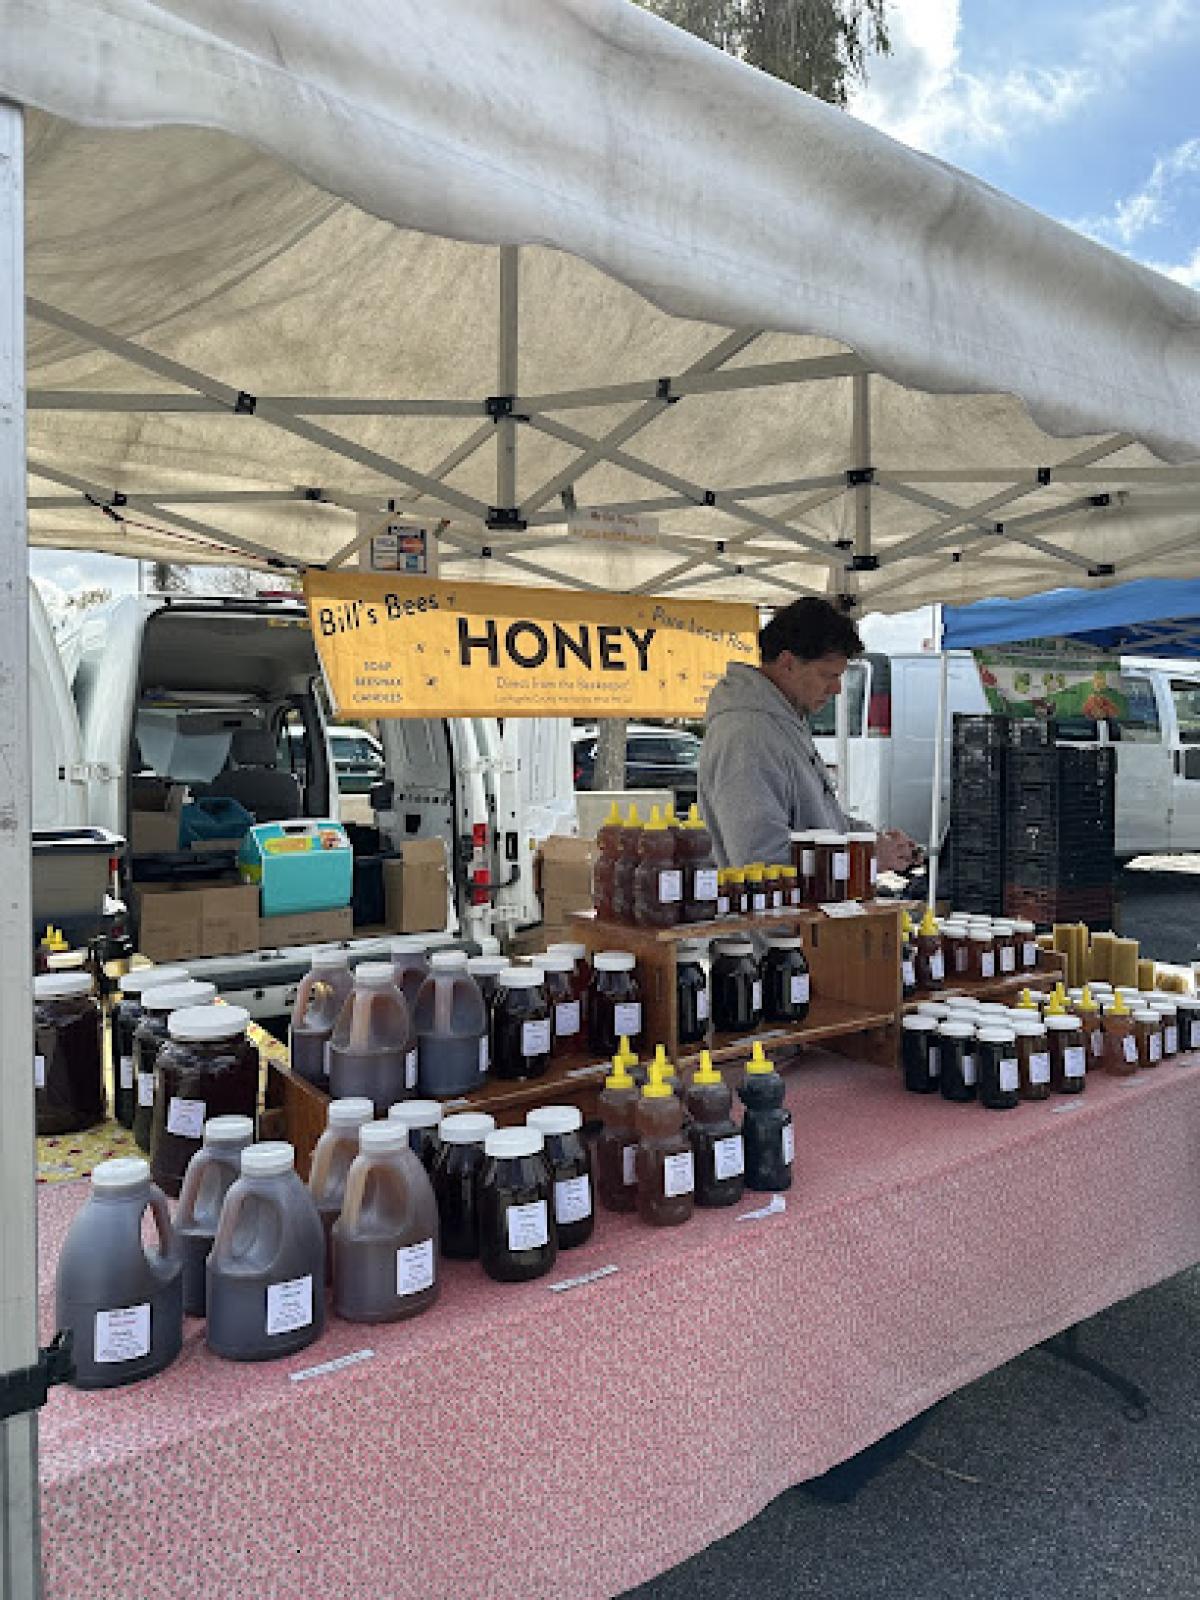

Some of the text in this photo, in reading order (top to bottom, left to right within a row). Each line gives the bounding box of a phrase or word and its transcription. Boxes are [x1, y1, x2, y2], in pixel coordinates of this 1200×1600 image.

[320, 593, 439, 636] Bill's Bees
[457, 617, 656, 671] HONEY
